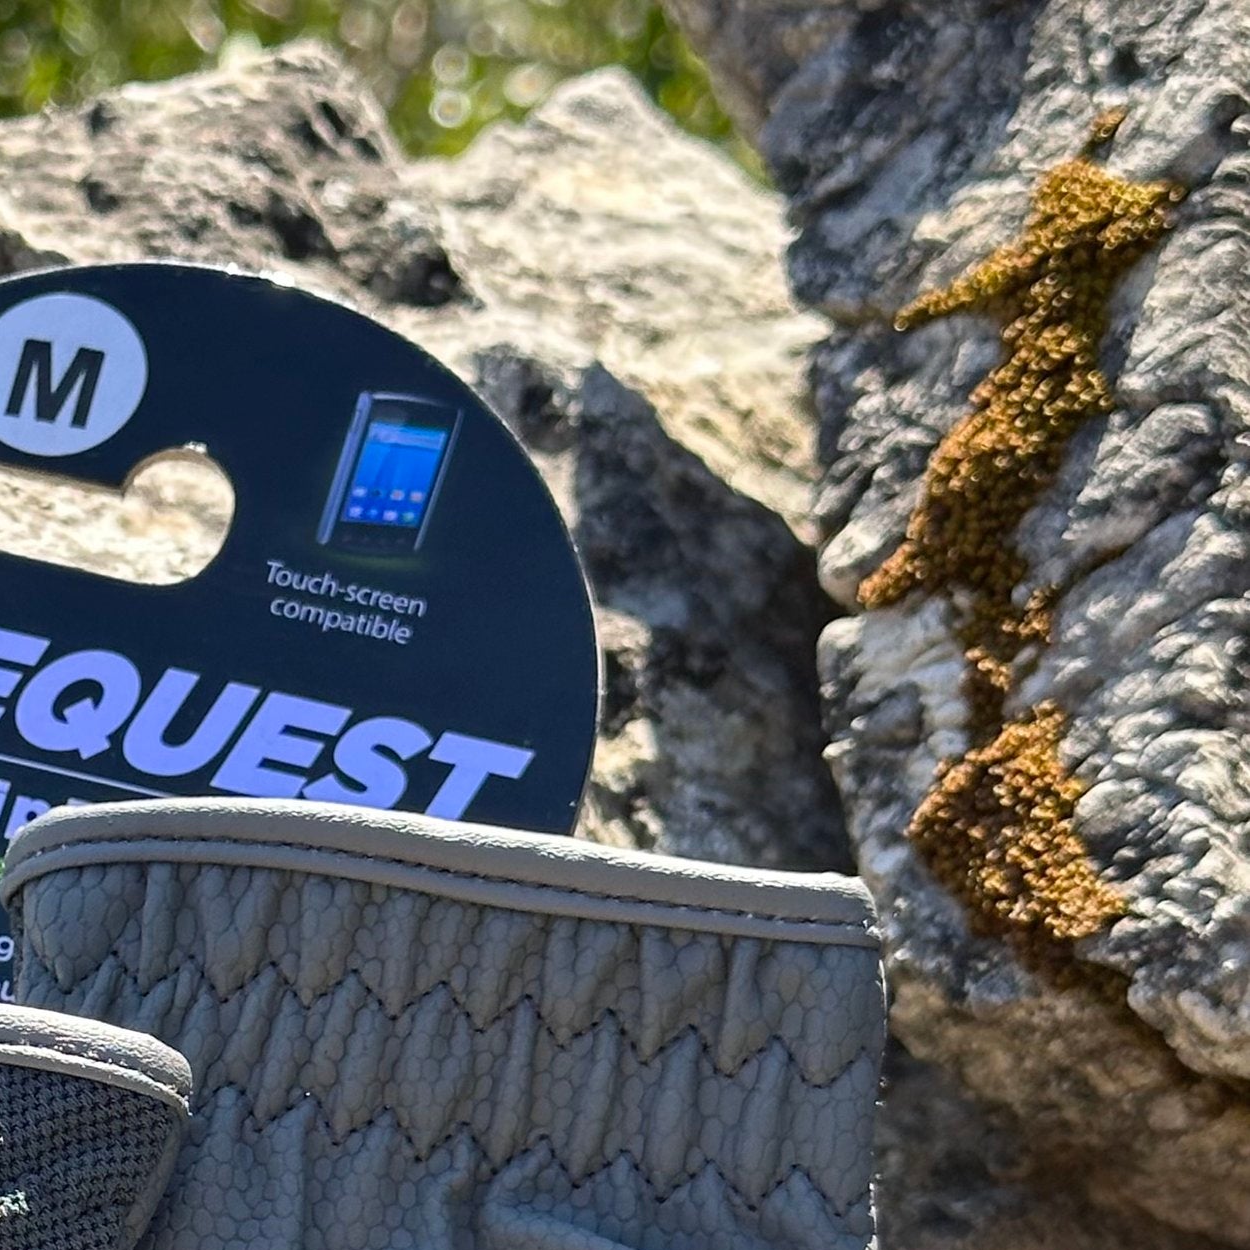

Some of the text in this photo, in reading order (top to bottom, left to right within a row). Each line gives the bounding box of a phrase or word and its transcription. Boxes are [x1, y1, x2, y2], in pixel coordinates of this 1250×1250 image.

[5, 339, 105, 430] M
[266, 560, 427, 617] Touch-screen
[270, 598, 413, 644] compatible
